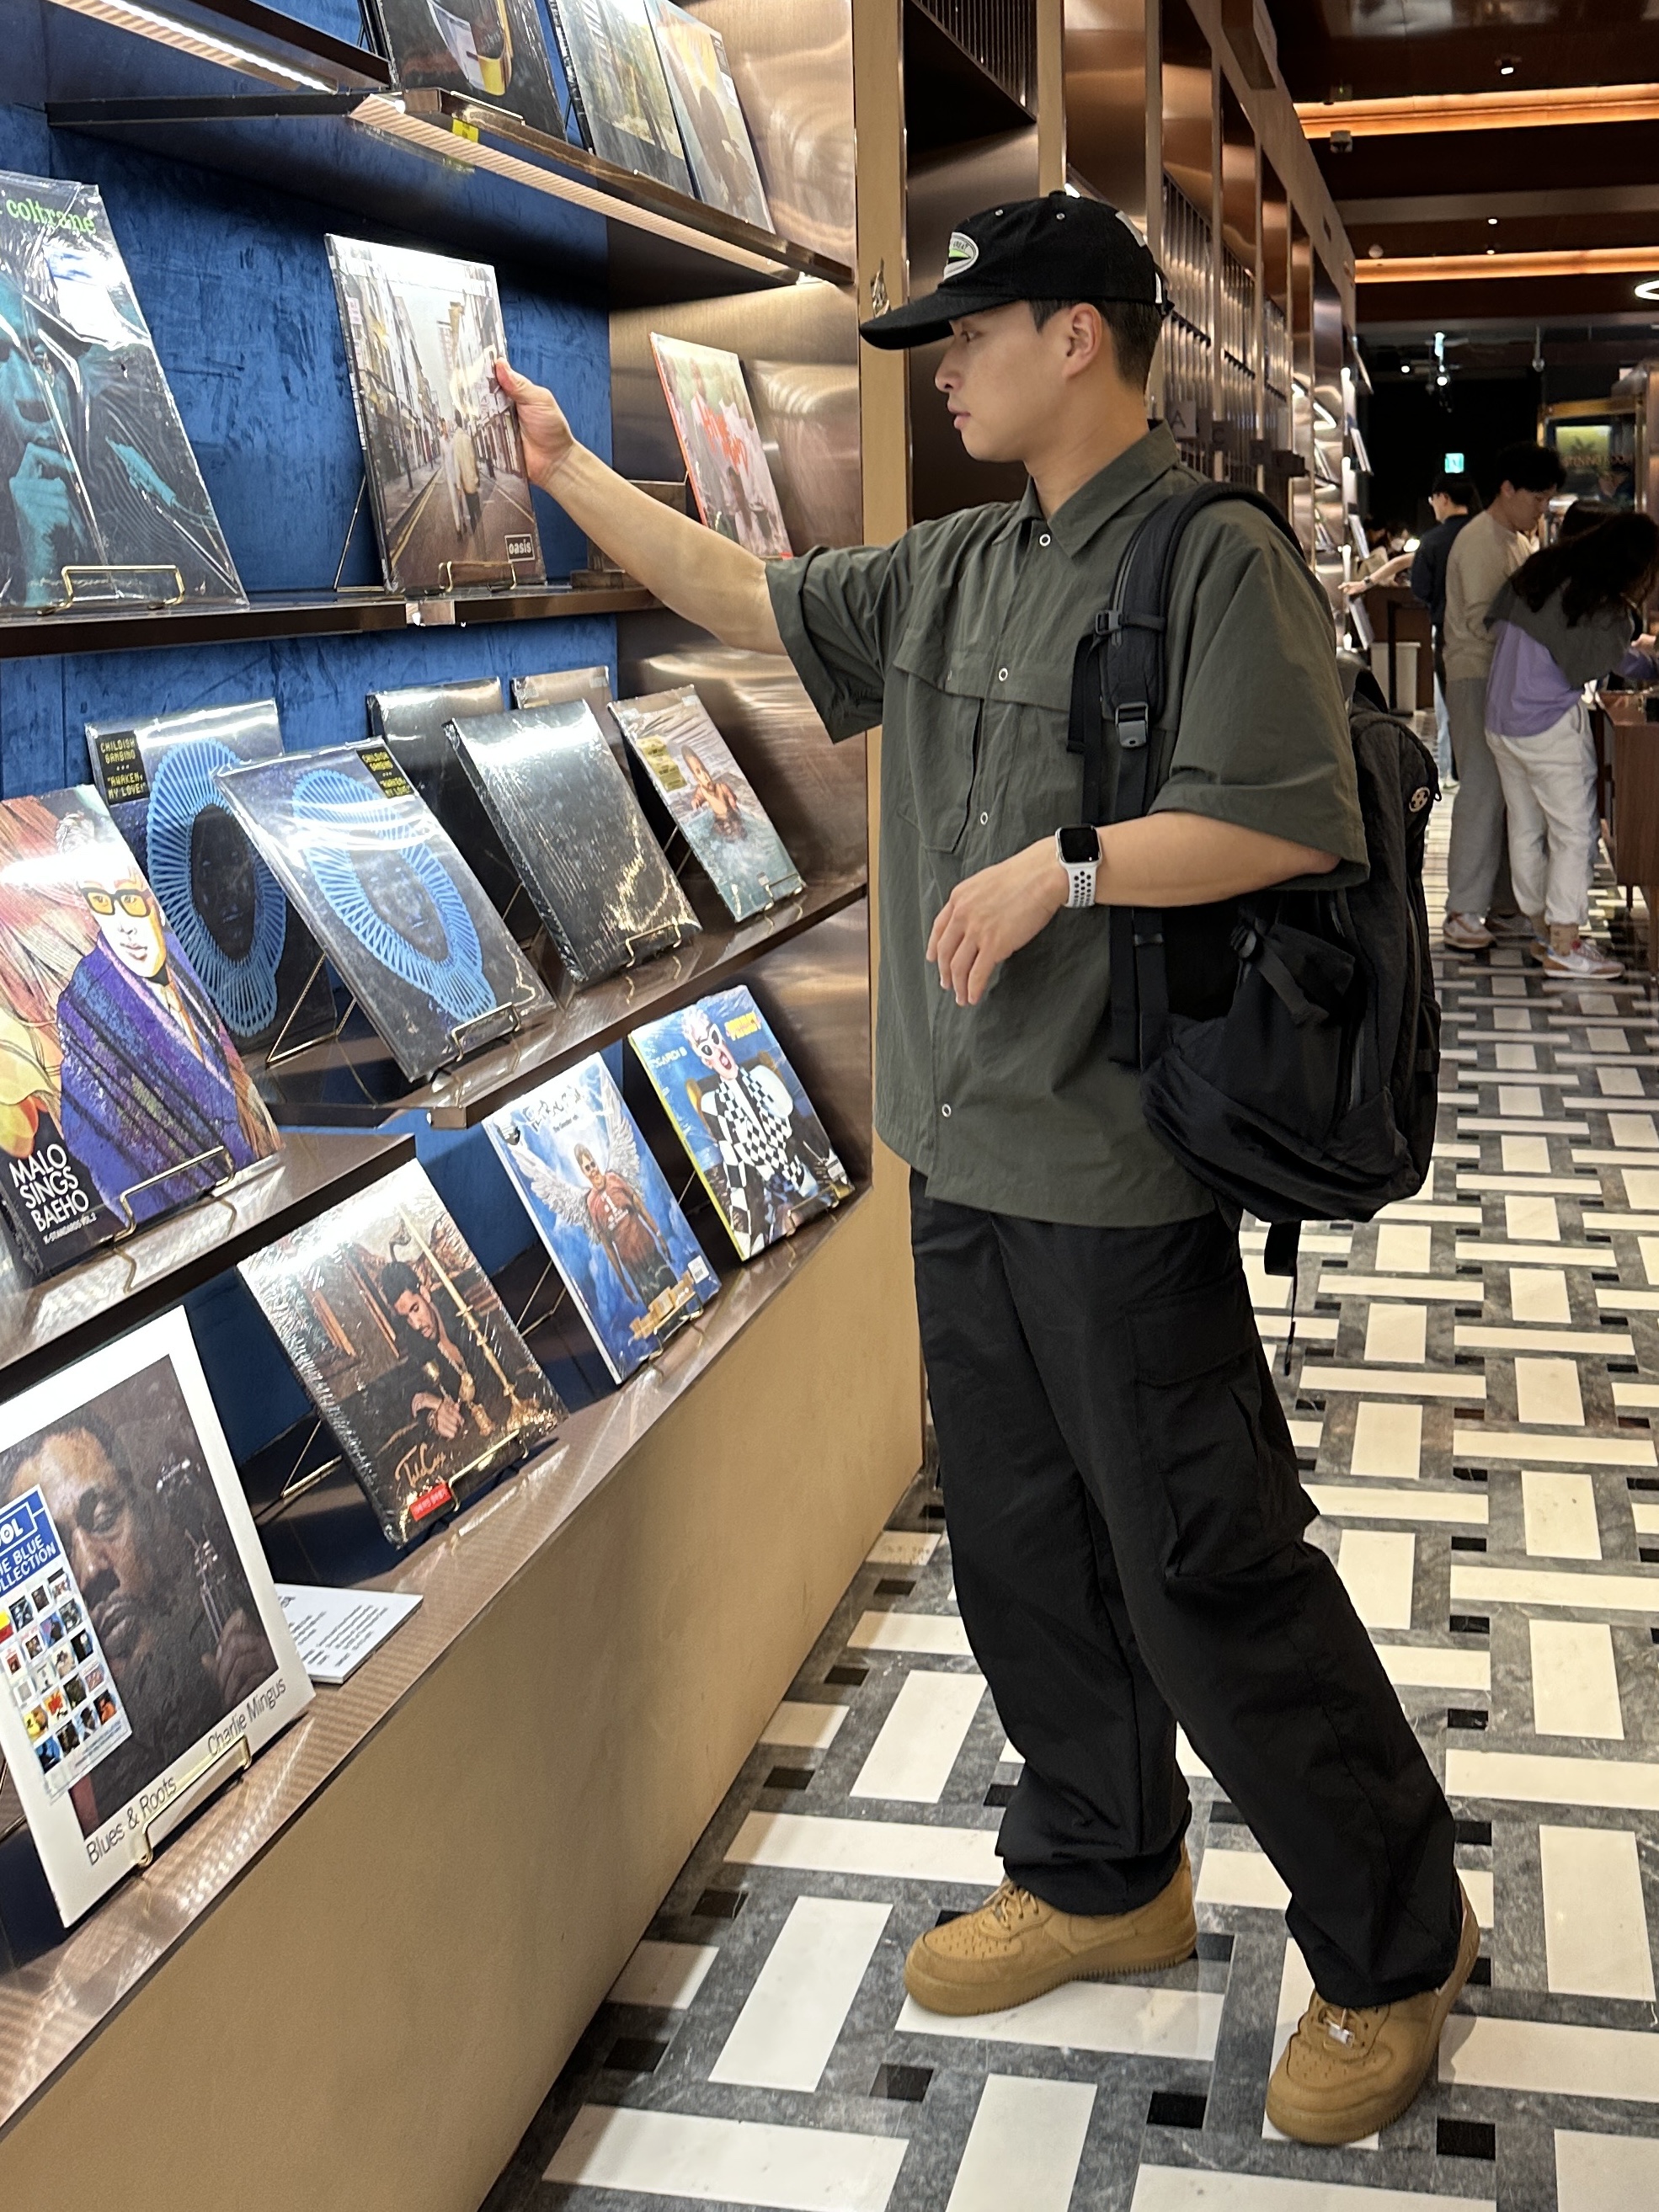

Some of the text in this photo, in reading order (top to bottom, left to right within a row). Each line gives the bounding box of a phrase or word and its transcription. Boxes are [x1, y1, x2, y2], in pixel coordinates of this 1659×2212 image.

[6, 198, 96, 234] coltrane
[509, 539, 531, 554] oasis
[100, 738, 136, 754] CHILDISH
[104, 749, 136, 765] GAMBINO
[108, 786, 119, 800] MY
[9, 1143, 67, 1187] MALO
[19, 1166, 79, 1209] SINGS
[30, 1190, 89, 1232] BAEHO
[0, 1518, 24, 1546] OL
[13, 1534, 44, 1564] BLUE
[0, 1542, 56, 1591] LLECTION
[208, 1678, 286, 1756] Charlie Mingus
[86, 1777, 178, 1865] Blues & Roots
